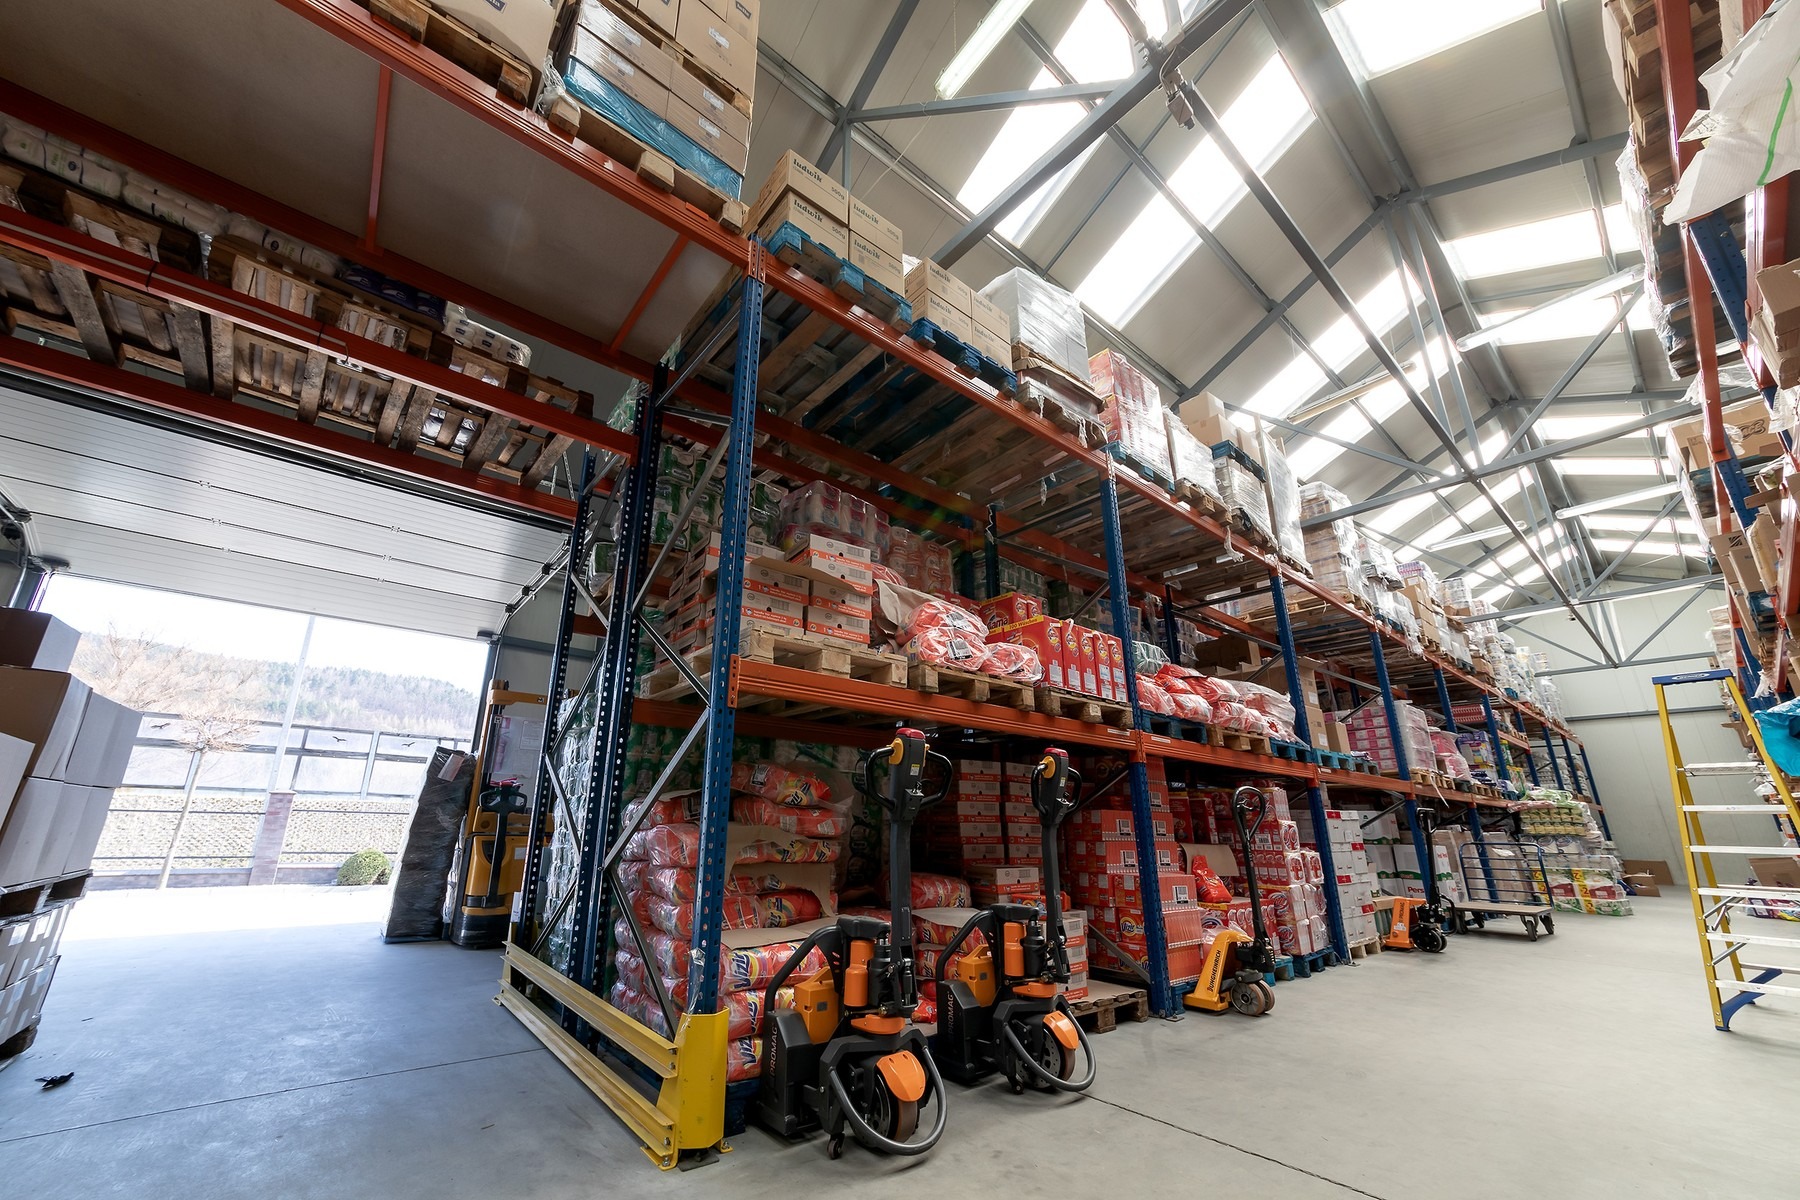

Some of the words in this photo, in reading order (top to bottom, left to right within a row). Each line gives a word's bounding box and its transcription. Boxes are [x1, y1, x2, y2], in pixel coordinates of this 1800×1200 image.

[793, 159, 822, 183] ludwik
[831, 187, 845, 200] 500g
[794, 199, 823, 223] ludwik
[853, 203, 879, 225] ludwik
[854, 239, 880, 260] ludwik
[929, 264, 951, 283] ludwik
[930, 297, 952, 315] ludwik
[731, 952, 752, 990] Vizir
[1207, 949, 1222, 993] JUNGHEINRICH
[769, 1026, 779, 1077] PROMAG
